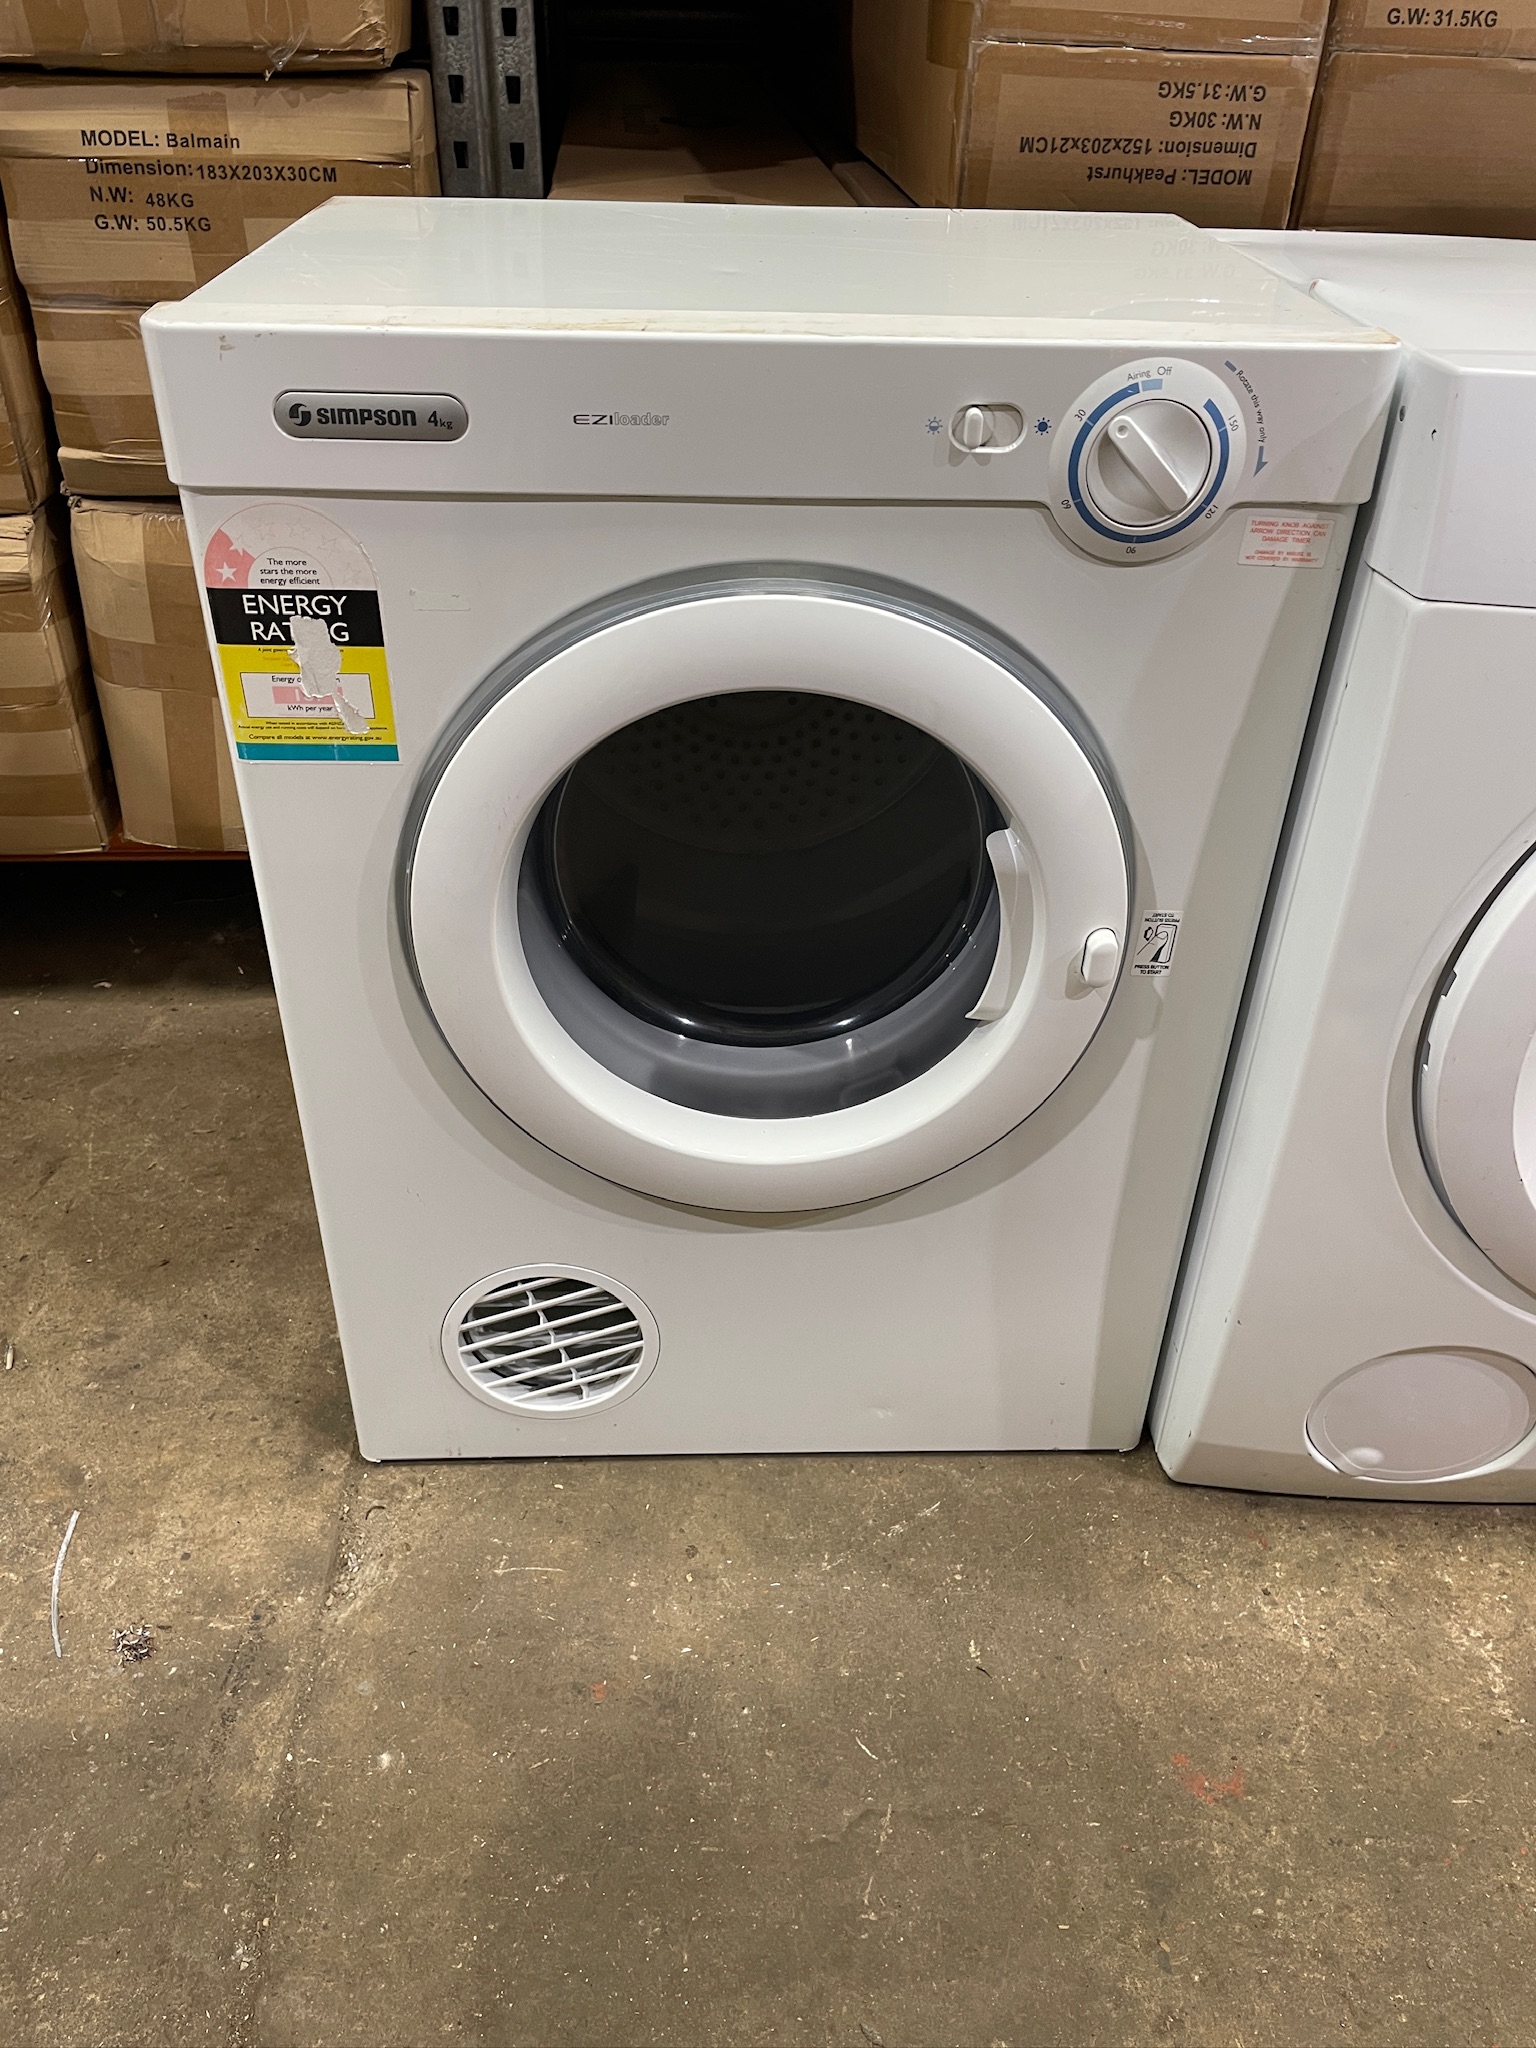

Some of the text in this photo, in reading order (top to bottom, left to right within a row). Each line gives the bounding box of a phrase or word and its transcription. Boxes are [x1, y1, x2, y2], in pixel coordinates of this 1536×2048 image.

[1387, 7, 1498, 27] G.W: 31.5KG
[1158, 80, 1266, 102] G.W: 31.5KG
[1169, 110, 1262, 131] N.W: 30KG
[80, 129, 240, 149] MODEL: Balmain
[1019, 136, 1258, 158] Dimension: 152x203x21CM
[86, 159, 337, 183] Dimension: 183X203X30CM
[1087, 166, 1253, 186] MODEL: Peakhurst
[90, 186, 194, 208] N.W: 48KG
[94, 214, 212, 232] G.W: 50.5KG
[1127, 370, 1152, 381] Airing
[1157, 366, 1172, 376] Off
[1074, 408, 1087, 422] 30
[1235, 369, 1267, 443] Rotate this way only
[316, 407, 417, 426] SIMPSON
[1227, 414, 1240, 432] 150
[1061, 499, 1072, 510] 60
[1204, 503, 1219, 520] 120
[1251, 520, 1279, 528] TURNING
[1276, 528, 1311, 536] DIRECTION
[1126, 546, 1137, 555] 90
[267, 557, 284, 566] The
[260, 577, 321, 586] energy efficient
[242, 593, 348, 616] ENERGY
[271, 675, 295, 684] Energy
[248, 733, 275, 741] Compare
